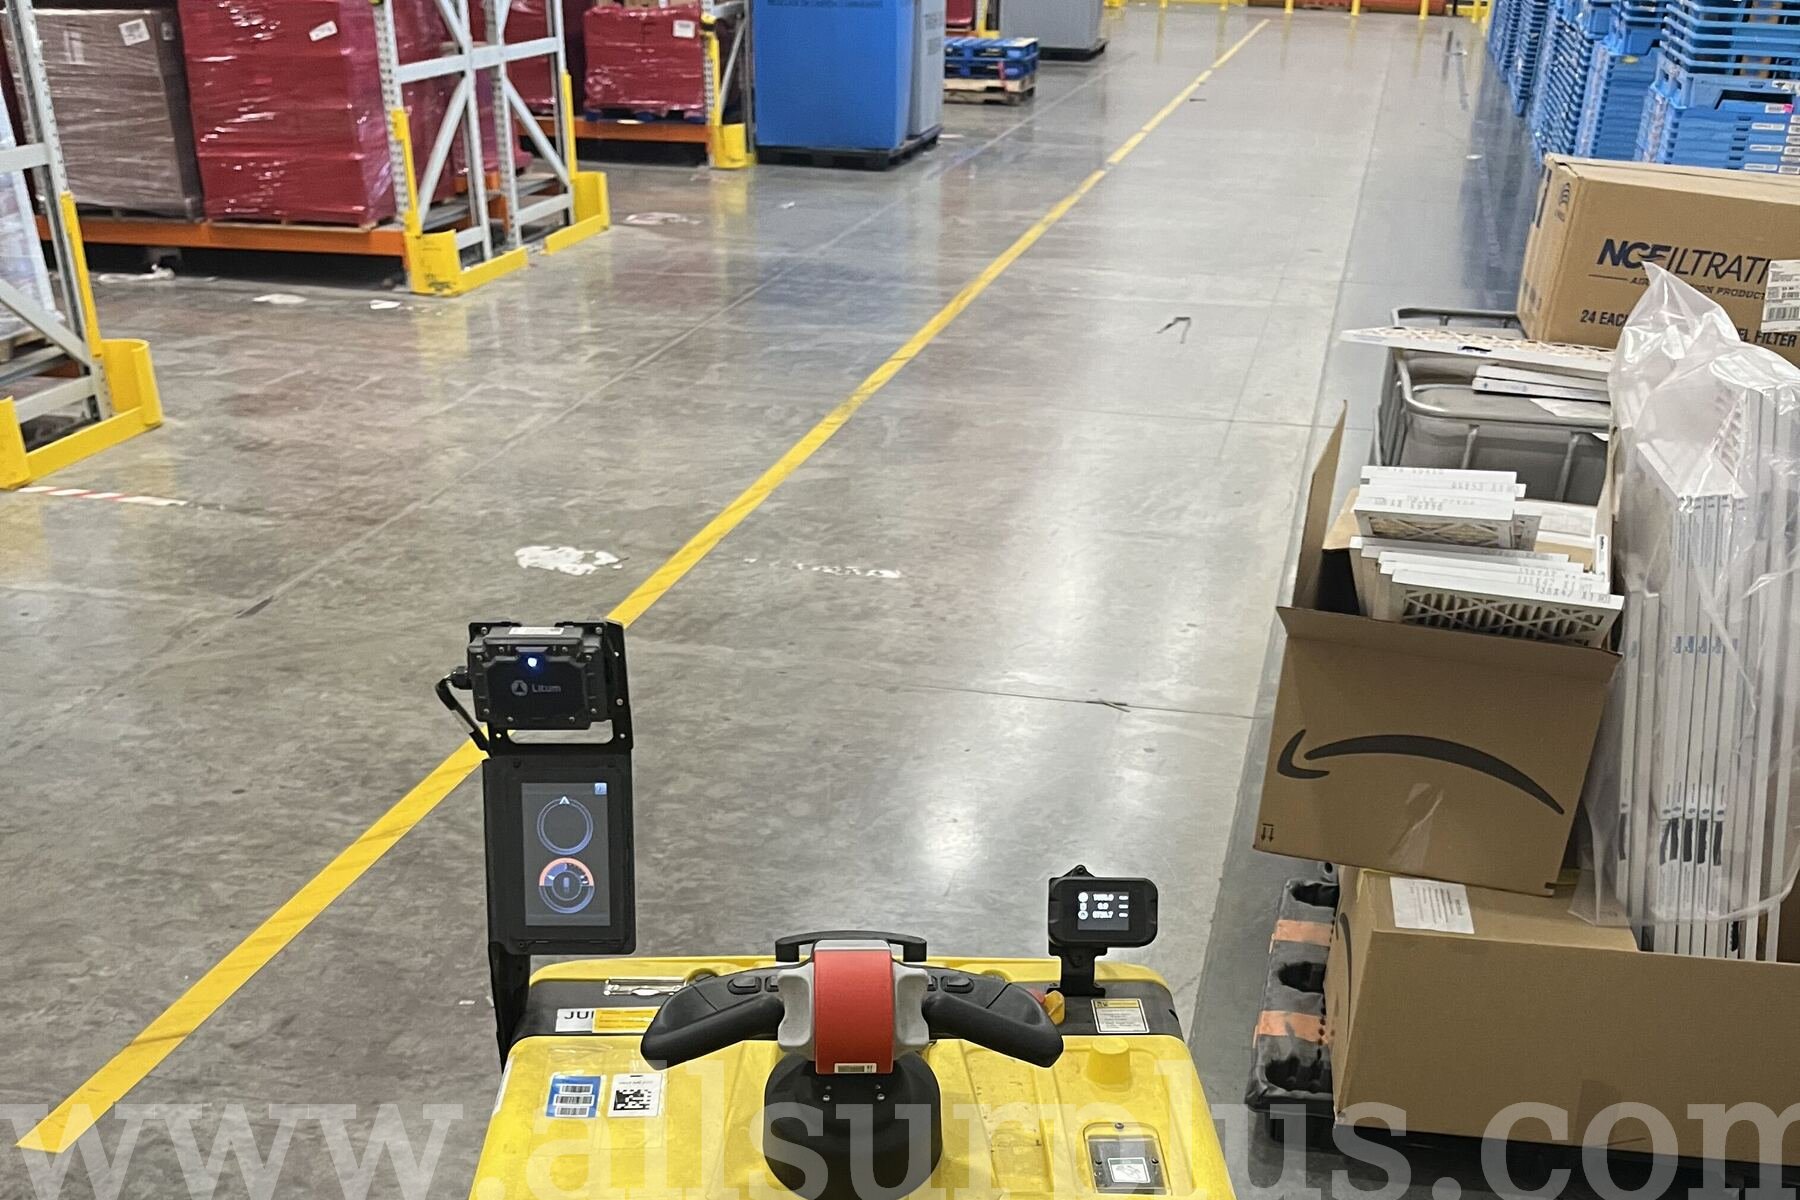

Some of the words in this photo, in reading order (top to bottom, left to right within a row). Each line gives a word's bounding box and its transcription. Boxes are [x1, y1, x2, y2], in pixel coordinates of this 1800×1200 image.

[1597, 238, 1772, 285] NCFILTRATI
[1716, 287, 1766, 300] PRODUCT
[1580, 309, 1597, 324] 24
[1754, 330, 1797, 348] FILTER
[563, 1010, 595, 1020] JU
